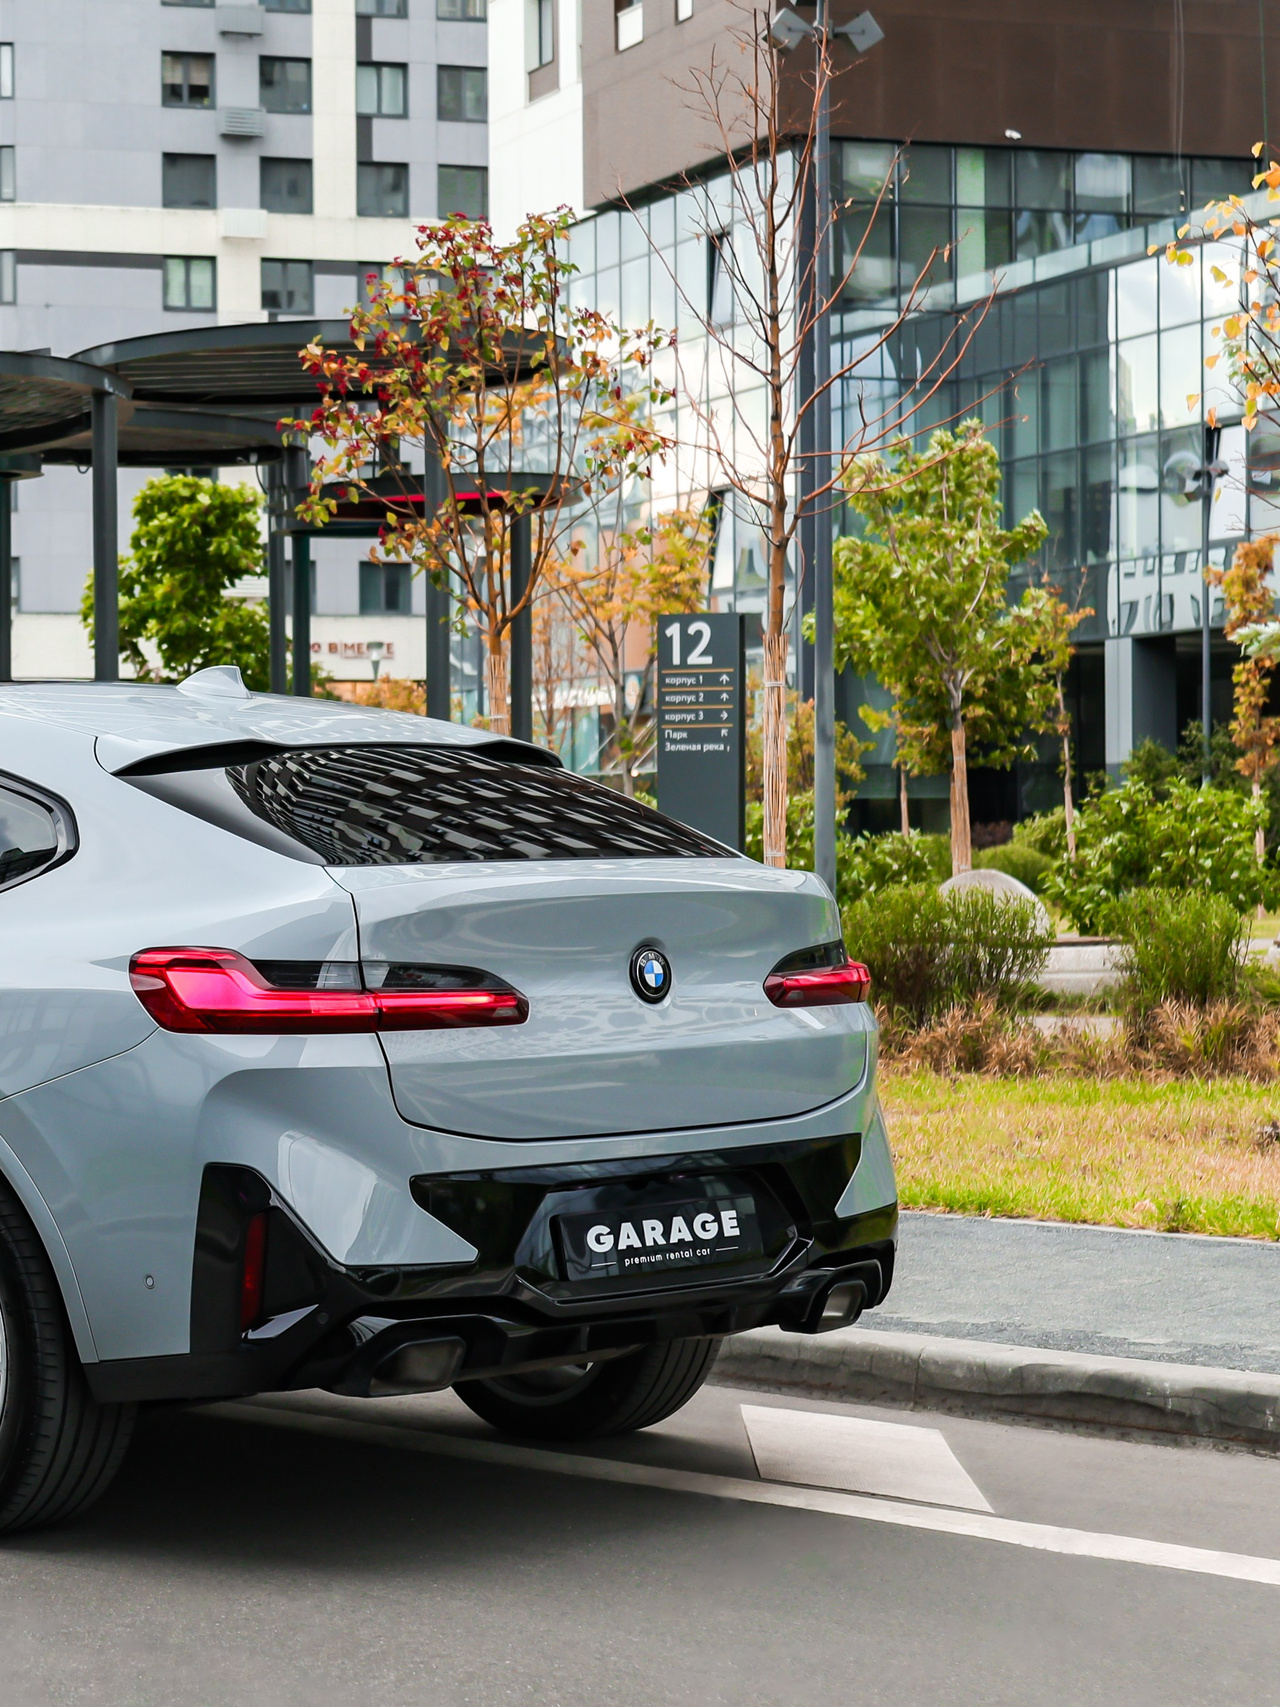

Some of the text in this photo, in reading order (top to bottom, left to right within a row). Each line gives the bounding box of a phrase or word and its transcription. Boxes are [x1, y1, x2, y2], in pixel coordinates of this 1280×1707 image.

[665, 621, 713, 666] 12
[665, 675, 703, 686] корпус 1
[665, 693, 704, 704] корпус 2
[665, 711, 704, 722] корпус 3
[665, 729, 688, 740] Парк
[665, 742, 724, 752] Зеленая река
[640, 953, 665, 967] BMW
[586, 1210, 740, 1253] GARAGE
[624, 1248, 711, 1267] premium rental car
